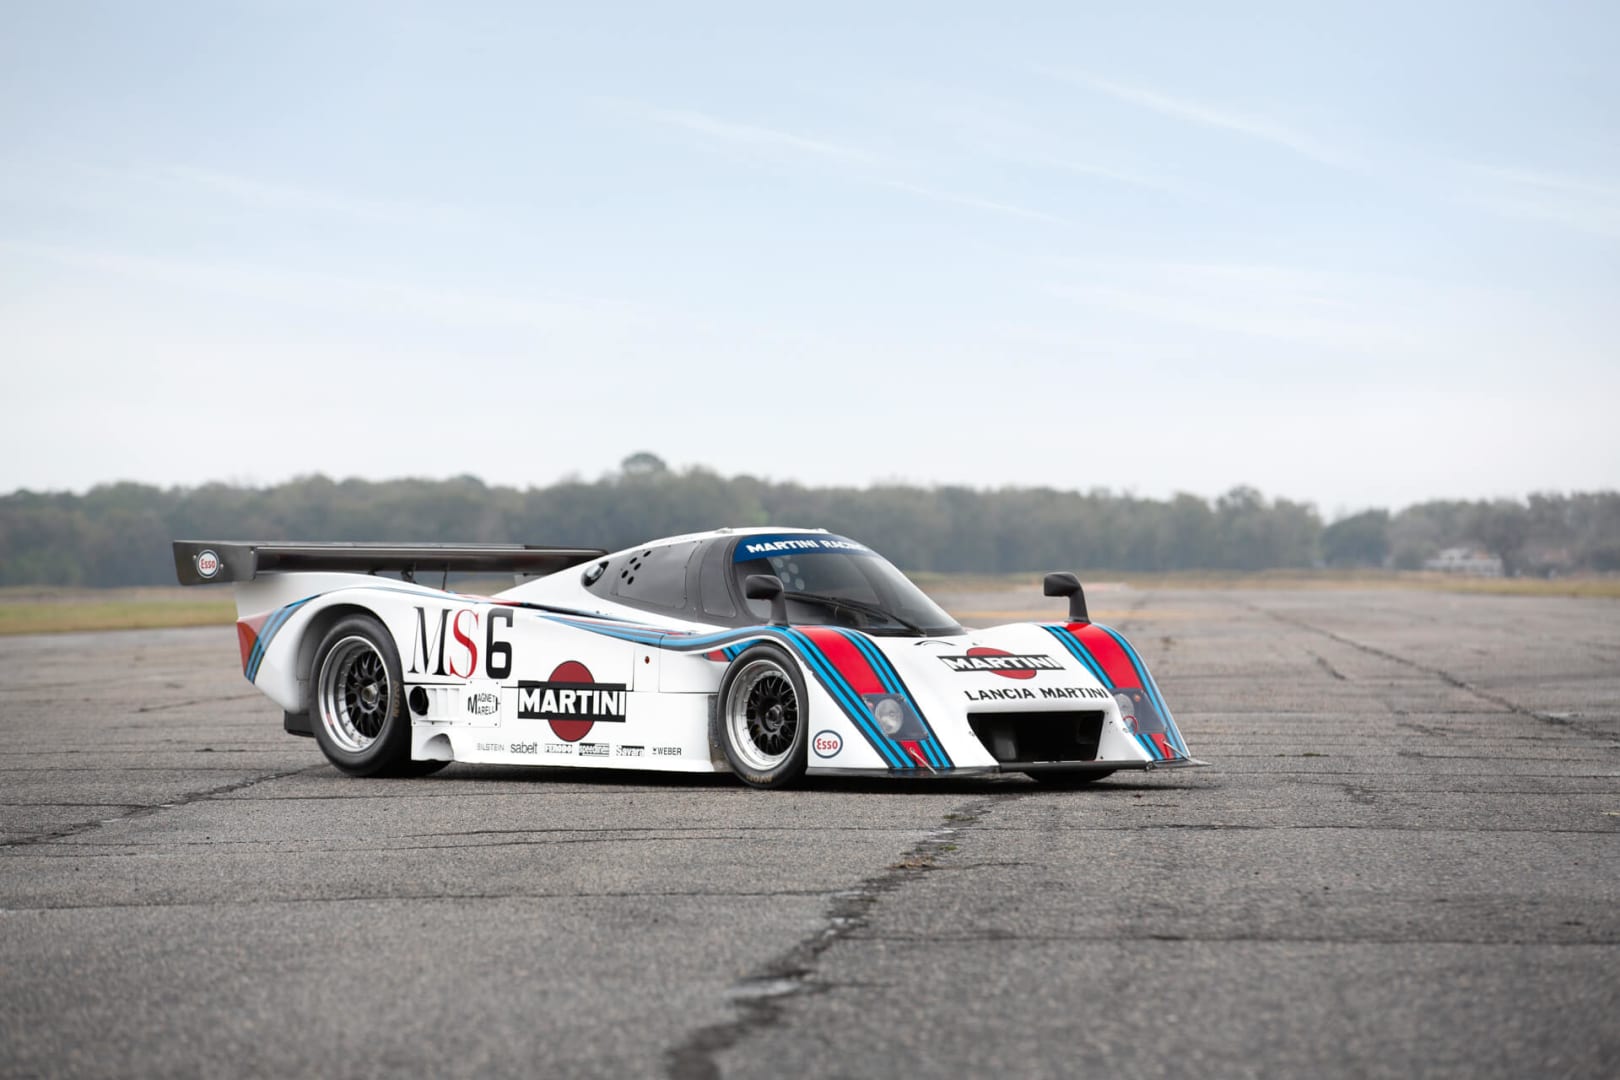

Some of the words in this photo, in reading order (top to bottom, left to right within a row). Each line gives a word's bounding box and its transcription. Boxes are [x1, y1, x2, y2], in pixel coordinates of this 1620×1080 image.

[746, 540, 820, 553] MARTINI
[485, 607, 514, 680] 6
[940, 656, 1060, 670] MARTINI
[964, 688, 1036, 701] LANCIA
[1038, 687, 1109, 700] MARTINI
[518, 687, 626, 716] MARTINI
[510, 741, 538, 754] sabelt
[816, 738, 839, 750] Esso
[657, 747, 682, 756] WEBER
